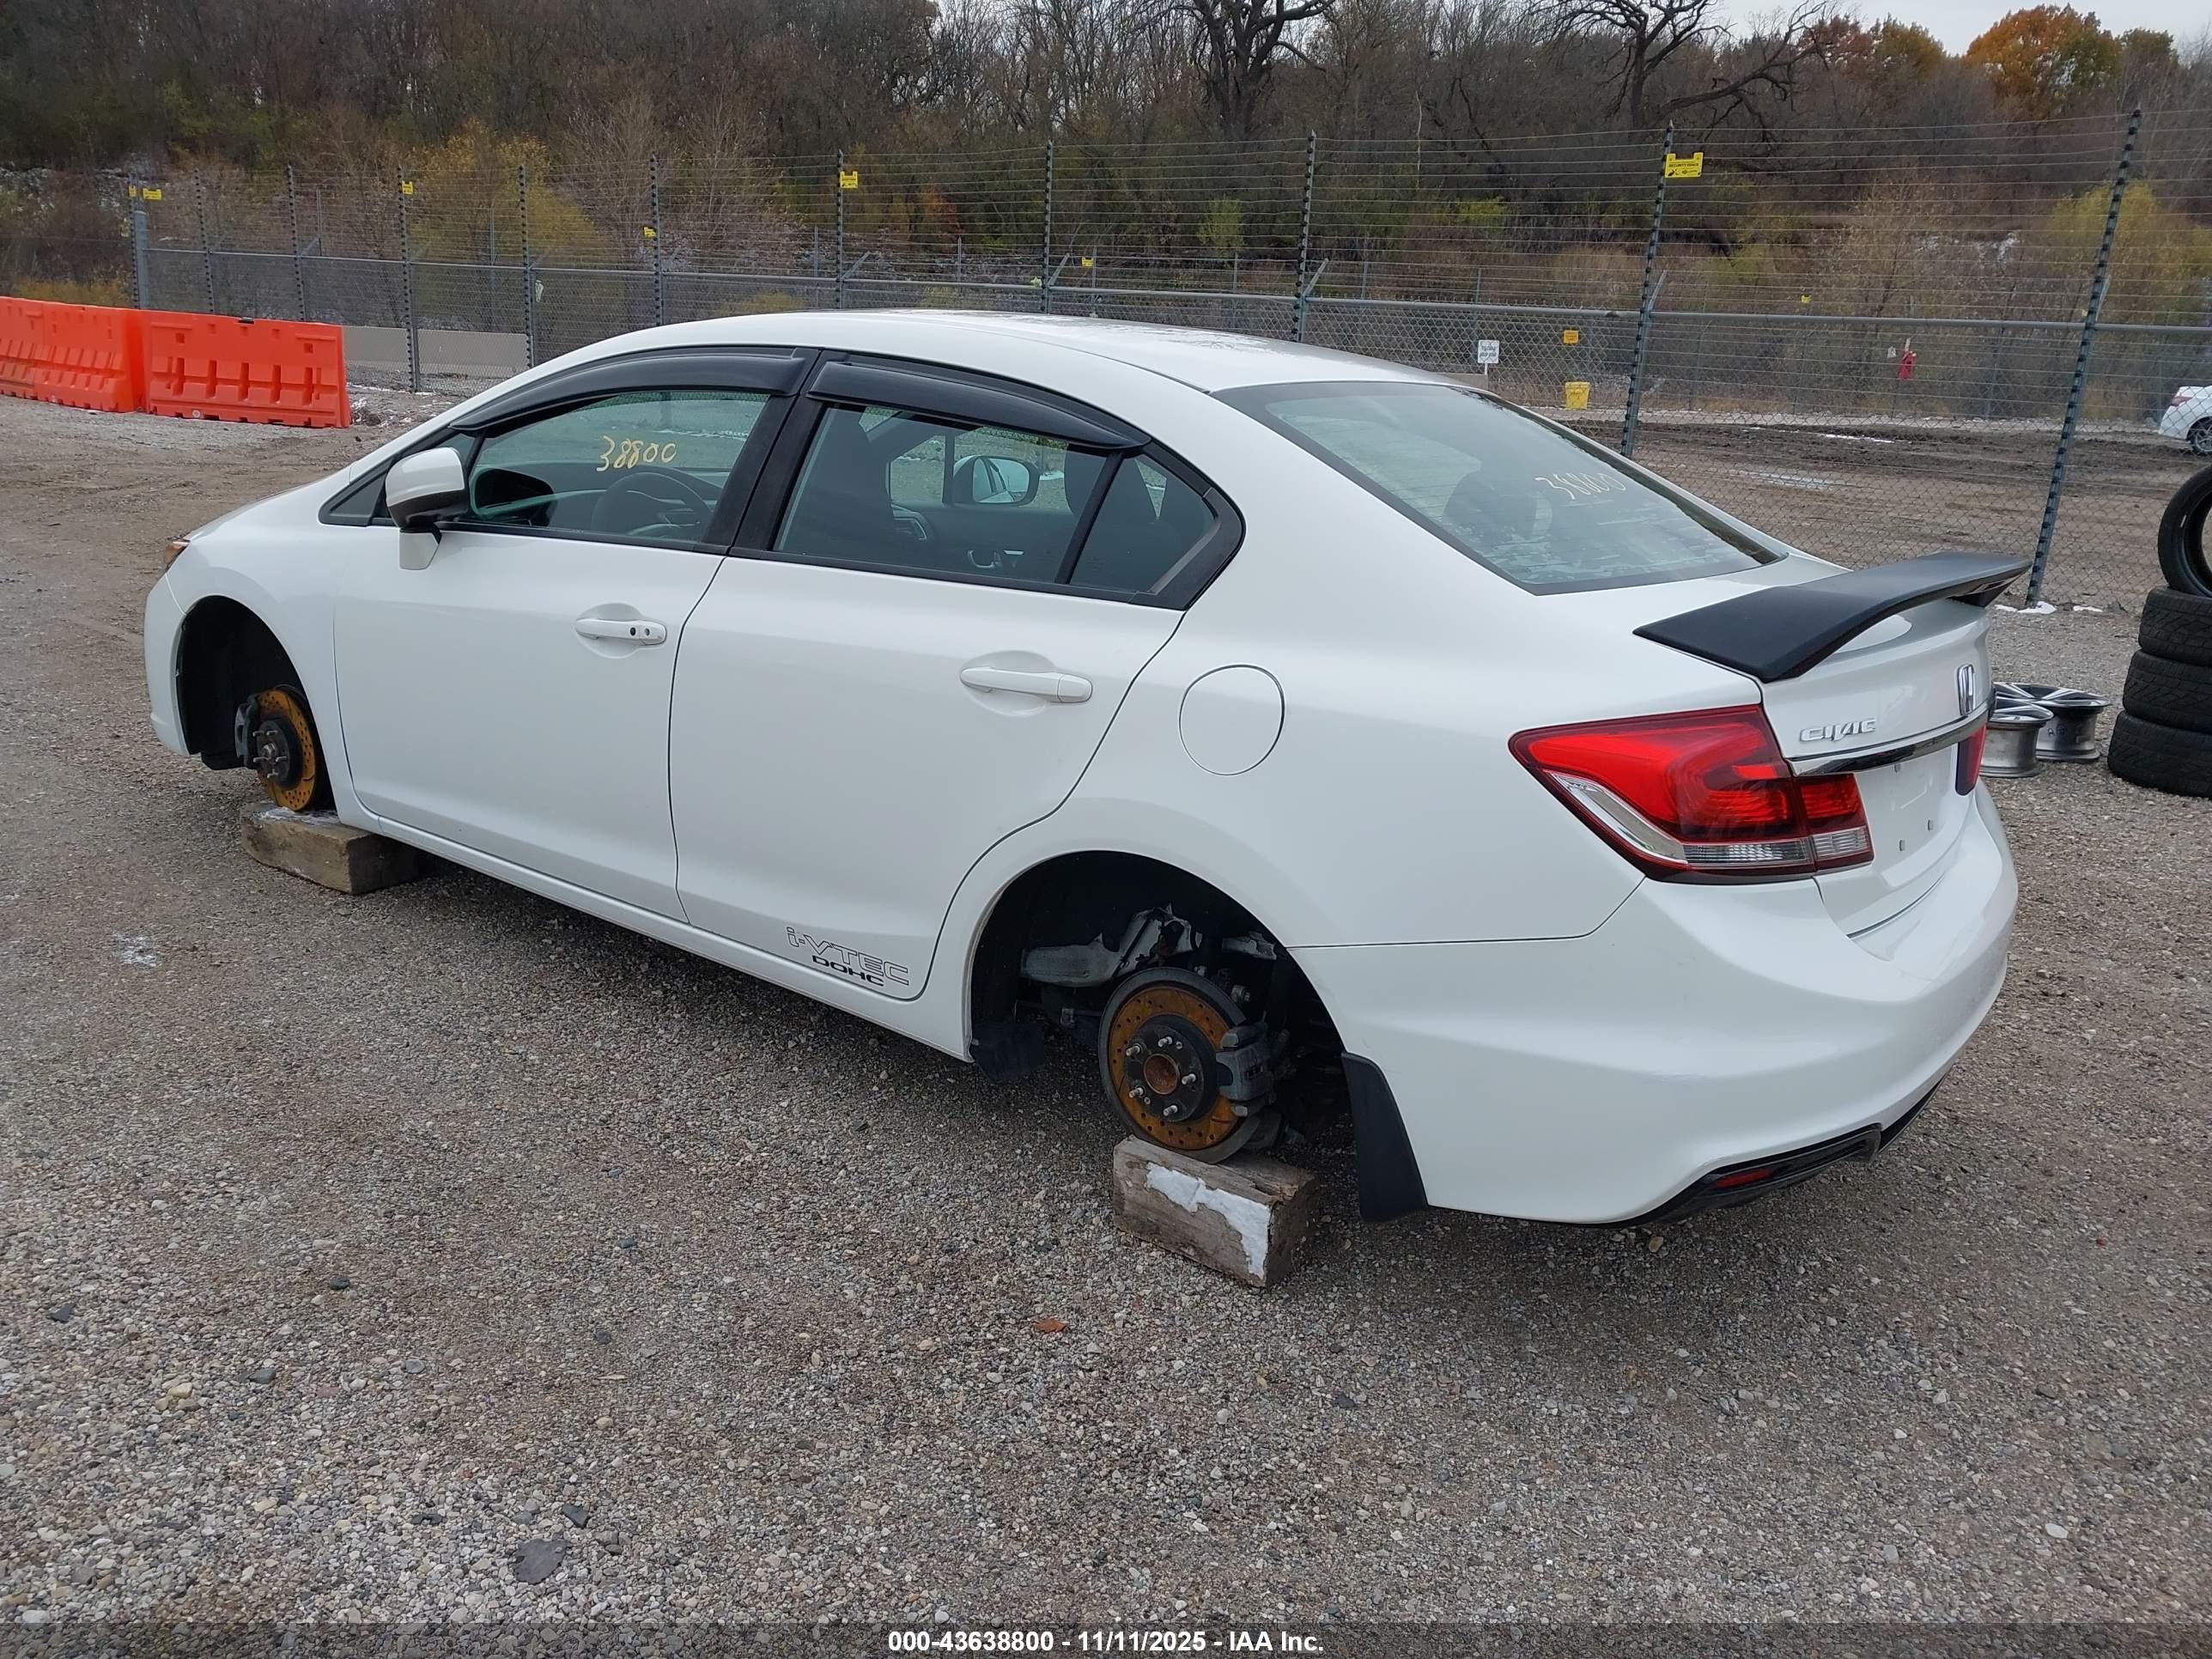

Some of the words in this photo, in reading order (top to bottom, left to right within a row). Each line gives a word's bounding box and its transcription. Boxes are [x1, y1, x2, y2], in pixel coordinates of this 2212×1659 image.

[596, 435, 677, 471] 38800
[1800, 718, 1876, 741] CIVIC
[786, 927, 909, 986] i-VTEC
[812, 955, 884, 987] DOHC
